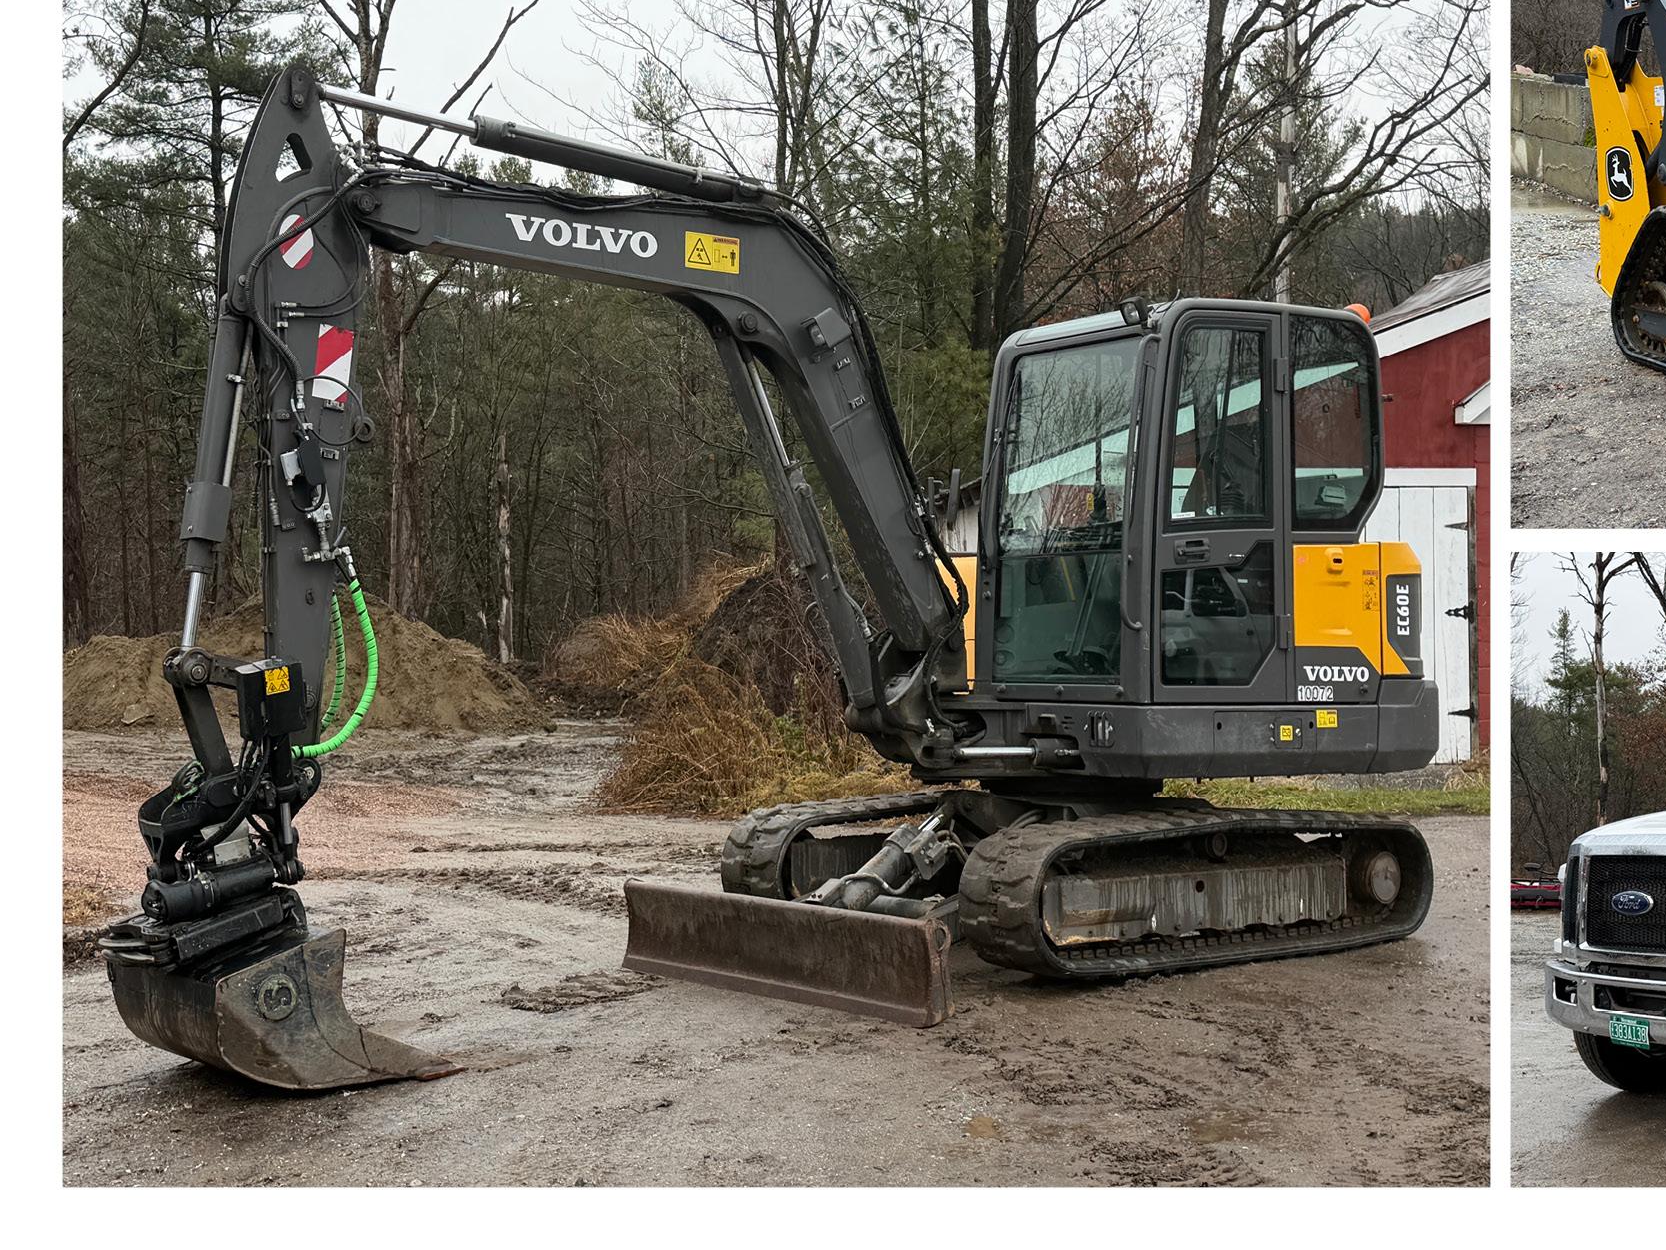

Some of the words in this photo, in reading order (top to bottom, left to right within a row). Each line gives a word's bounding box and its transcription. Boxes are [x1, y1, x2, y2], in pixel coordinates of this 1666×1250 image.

[505, 213, 658, 258] VOLVO
[1396, 584, 1410, 636] EC60E
[1303, 666, 1370, 681] VOLVO
[1297, 686, 1334, 701] 10072
[1617, 894, 1641, 910] Ford
[1613, 1023, 1646, 1042] 383A138
